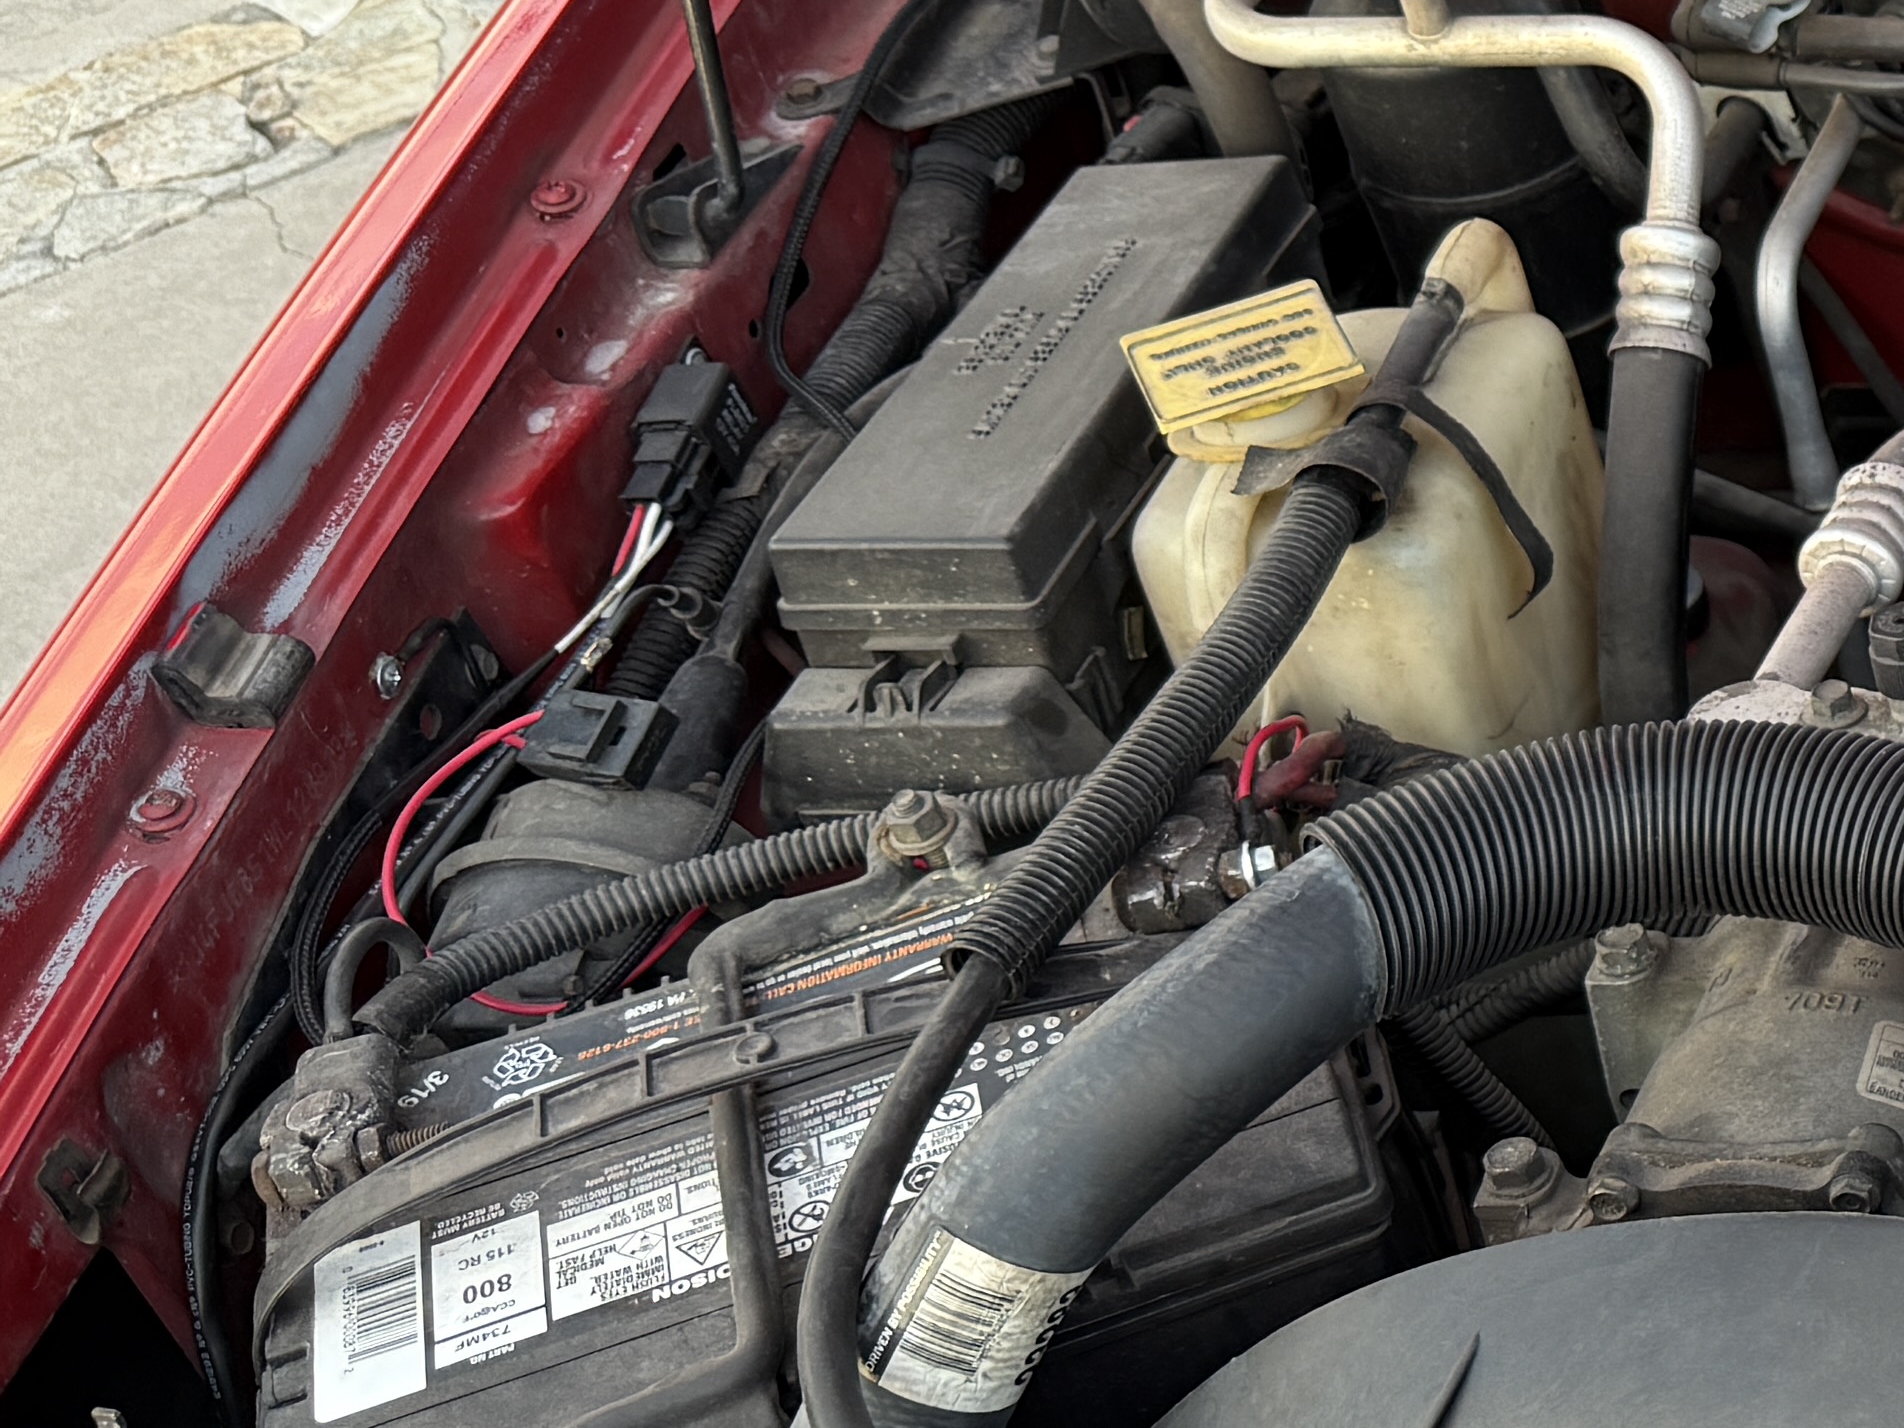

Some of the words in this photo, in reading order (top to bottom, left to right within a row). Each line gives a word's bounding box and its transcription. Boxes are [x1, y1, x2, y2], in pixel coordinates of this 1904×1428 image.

[1223, 323, 1317, 361] COOLANT
[1160, 355, 1216, 381] ONLY
[1208, 360, 1300, 398] CAUTION
[882, 931, 955, 963] WARRANTY
[793, 953, 884, 990] INFORMATION
[398, 1069, 450, 1109] 3/19
[487, 1202, 501, 1212] BE
[629, 1198, 653, 1213] NOT
[655, 1192, 672, 1204] DO
[657, 1200, 673, 1212] DO
[460, 1208, 506, 1229] BATTERY
[632, 1206, 655, 1220] NOT
[429, 1223, 461, 1239] MUST
[602, 1214, 631, 1231] OPEN
[469, 1227, 497, 1243] 12V
[484, 1243, 514, 1261] 115
[586, 1242, 617, 1260] HELP
[456, 1253, 483, 1271] RC
[554, 1255, 605, 1280] MEDICAL
[634, 1253, 664, 1270] WITH
[459, 1271, 515, 1305] 800
[587, 1262, 665, 1296] IMMEDIATELY
[629, 1272, 666, 1291] FLUSH
[598, 1284, 628, 1301] EYES
[451, 1324, 511, 1352] 734MF
[866, 1329, 897, 1374] DRIVEN
[889, 1304, 902, 1328] BY
[486, 1342, 515, 1358] PART
